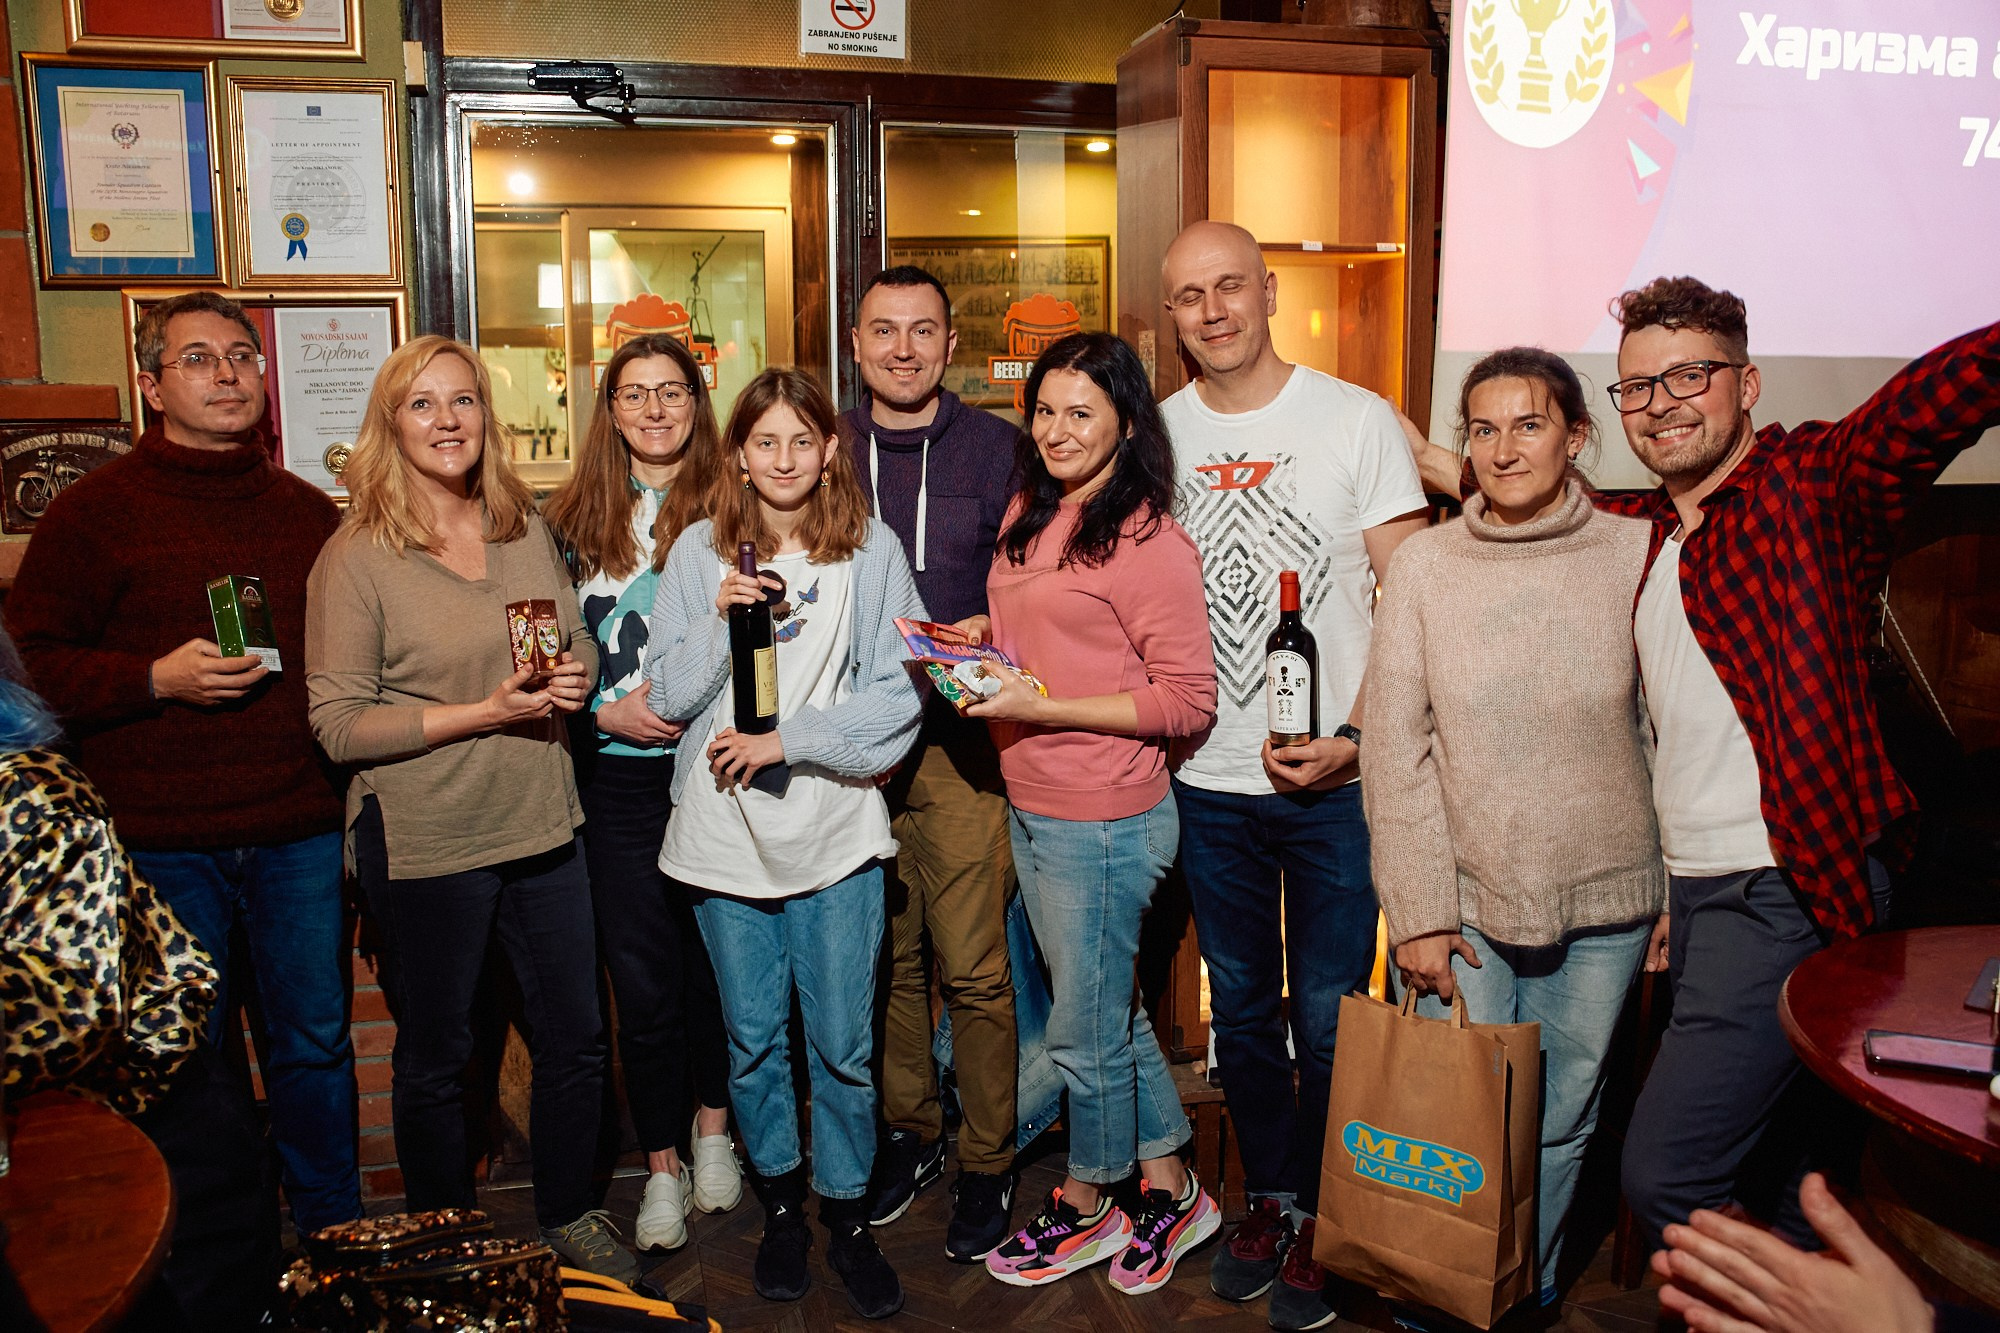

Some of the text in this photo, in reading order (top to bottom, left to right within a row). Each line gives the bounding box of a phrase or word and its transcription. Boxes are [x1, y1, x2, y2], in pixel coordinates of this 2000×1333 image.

[808, 29, 898, 42] ZABRANJENO PUŠENJE
[842, 44, 878, 53] SMOKING
[1736, 12, 1979, 81] Харизма
[300, 332, 368, 341] NOVOSADSKI SAJAM
[300, 342, 371, 367] Diploma
[994, 362, 1023, 379] BEER
[309, 380, 349, 388] NIKLANOVIĆ
[2, 432, 58, 460] LEGENDS
[61, 432, 106, 448] NEVER
[1353, 1126, 1474, 1184] MIX
[1359, 1158, 1458, 1198] Markt
